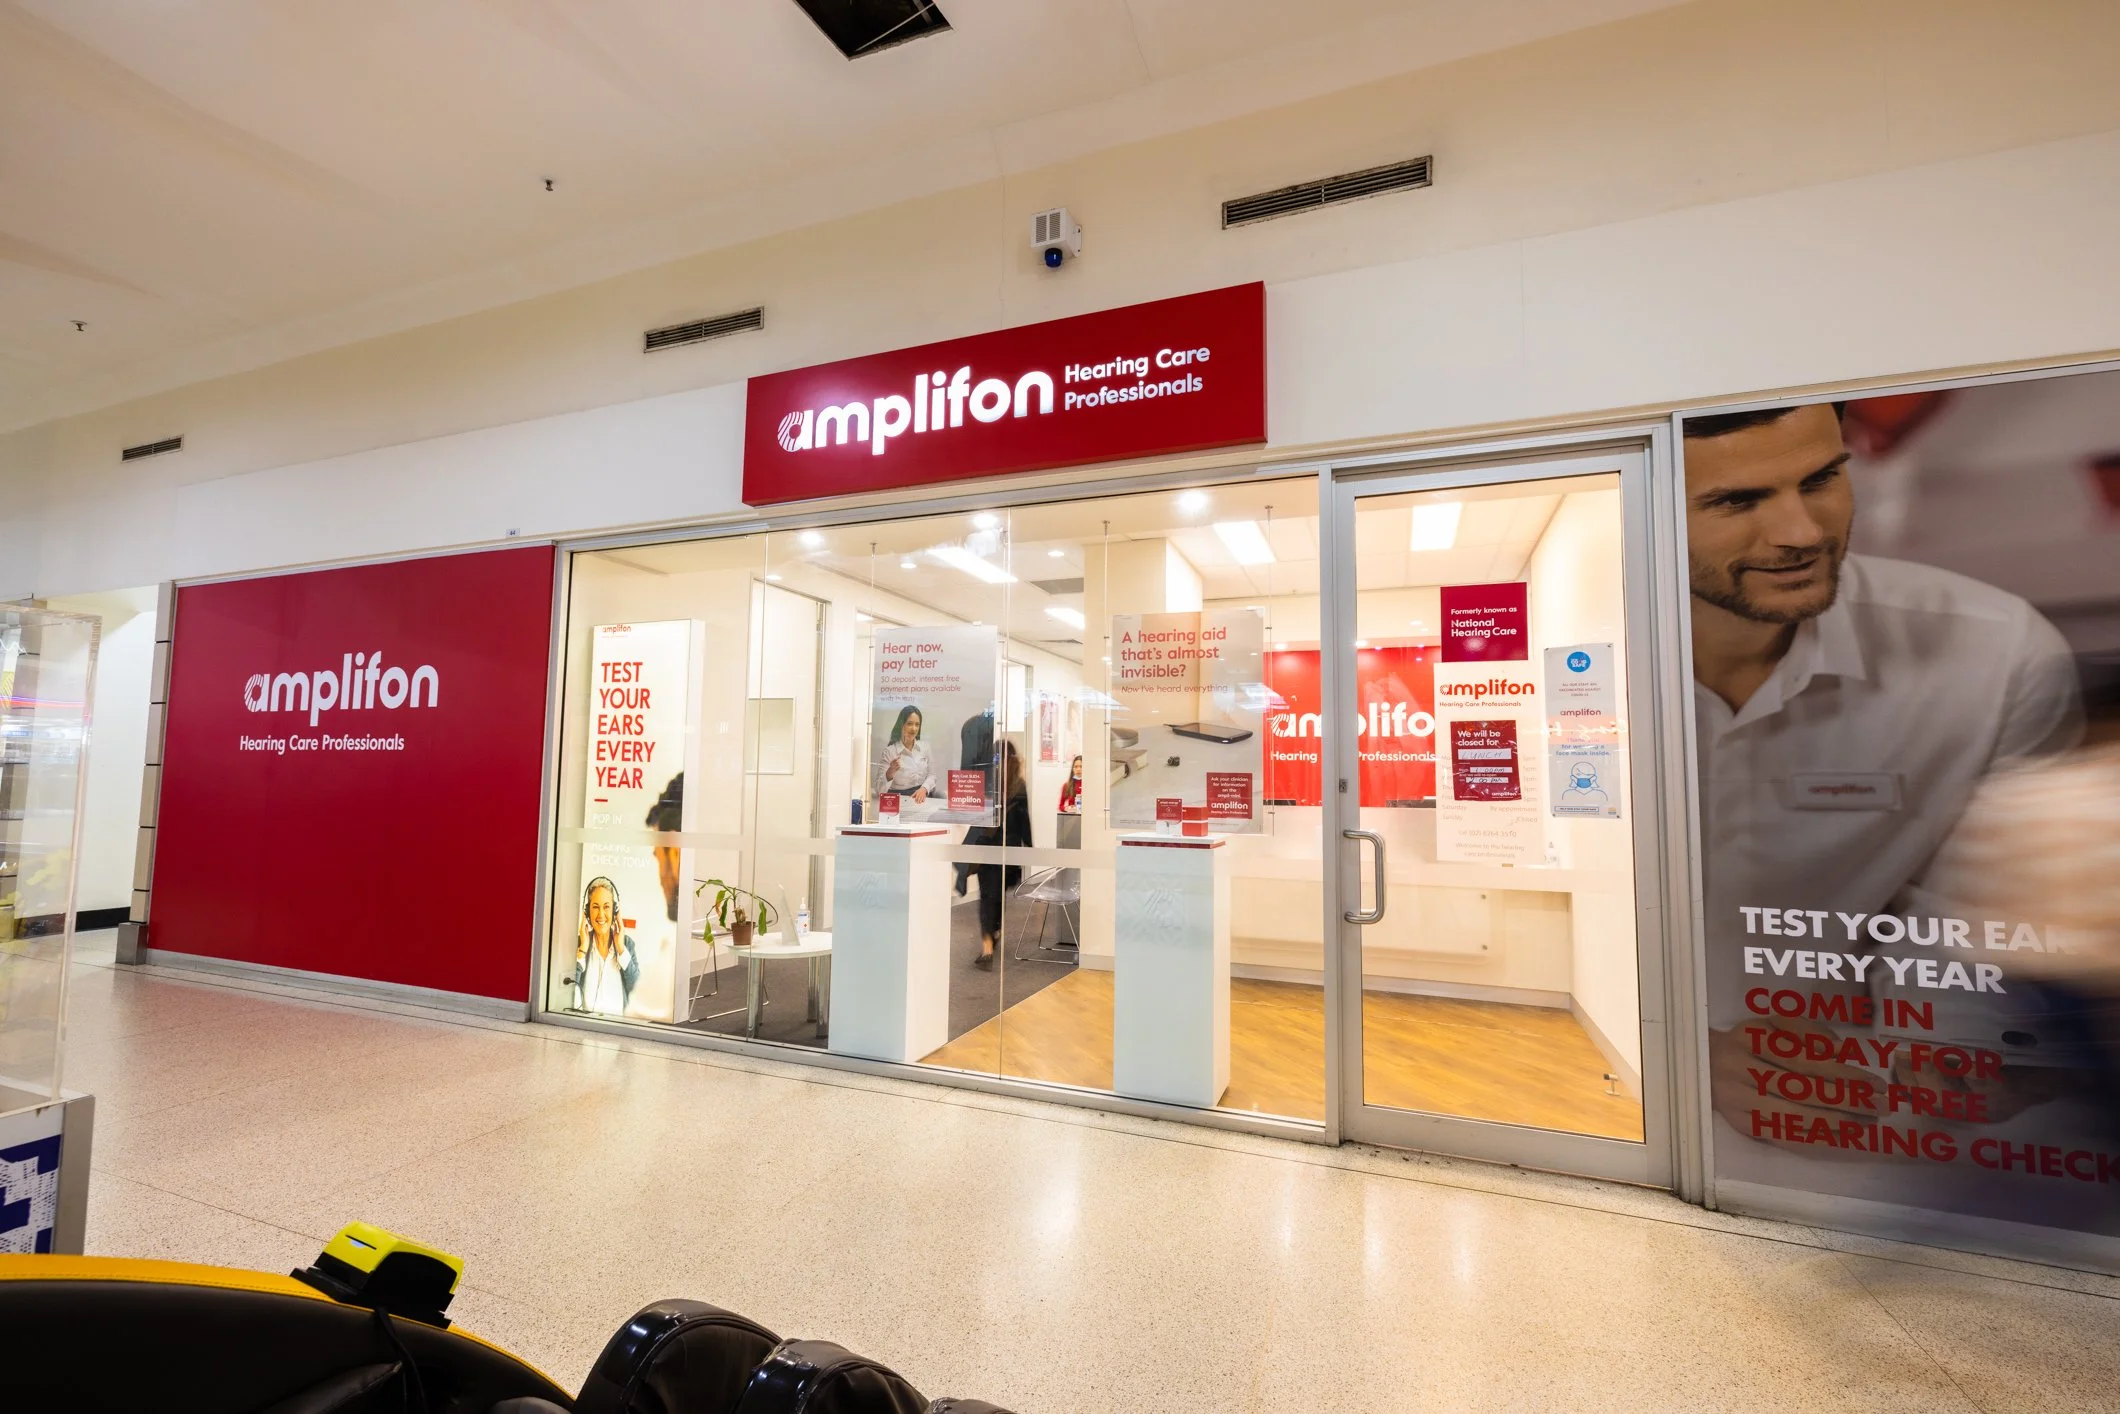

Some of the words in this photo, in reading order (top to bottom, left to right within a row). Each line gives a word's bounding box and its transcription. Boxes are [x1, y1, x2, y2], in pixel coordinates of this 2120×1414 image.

[1064, 355, 1149, 384] Hearing
[1155, 347, 1211, 370] Care
[1064, 373, 1204, 411] Professionals
[777, 366, 1054, 456] amplifon
[1450, 607, 1482, 616] Formerly
[1484, 606, 1507, 614] known
[1450, 618, 1495, 628] National
[1122, 631, 1132, 643] A
[1138, 628, 1197, 645] hearing
[1201, 627, 1227, 641] aid
[1450, 627, 1491, 640] Hearing
[1493, 626, 1517, 637] Care
[883, 642, 912, 654] Hear
[1121, 647, 1162, 661] that's
[1168, 646, 1219, 660] almost
[601, 661, 643, 683] TEST
[881, 660, 904, 672] pay
[908, 657, 938, 669] later
[1121, 664, 1187, 678] invisible?
[244, 651, 438, 727] amplifon
[880, 685, 909, 694] payment
[911, 685, 929, 693] plans
[930, 684, 961, 692] available
[1121, 685, 1139, 693] Now
[1156, 684, 1182, 693] heard
[1440, 679, 1535, 699] amplifon
[599, 687, 651, 710] YOUR
[1439, 701, 1464, 709] Hearing
[1560, 708, 1601, 717] amplifon
[597, 714, 645, 736] EARS
[1457, 730, 1471, 738] We
[1473, 730, 1488, 738] will
[240, 734, 286, 755] Hearing
[289, 734, 319, 752] Care
[322, 733, 405, 752] Professionals
[595, 740, 656, 764] EVERY
[1271, 751, 1318, 763] Hearing
[594, 766, 644, 789] YEAR
[952, 796, 981, 804] amplifon
[1211, 800, 1249, 811] amplifon
[613, 814, 622, 825] IN
[1739, 906, 1829, 939] TEST
[1835, 912, 1974, 949] YOUR
[1984, 920, 2079, 955] EAR
[1743, 947, 1876, 984] EVERY
[1881, 956, 2006, 994] YEAR
[1744, 988, 1873, 1026] COME
[1883, 998, 1934, 1031] IN
[1744, 1027, 1899, 1070] TODAY
[1910, 1043, 2004, 1084] FOR
[1747, 1068, 1876, 1110] YOUR
[1888, 1085, 1989, 1124] FREE
[1751, 1109, 1958, 1162] HEARING
[1970, 1137, 2120, 1184] CHECK
